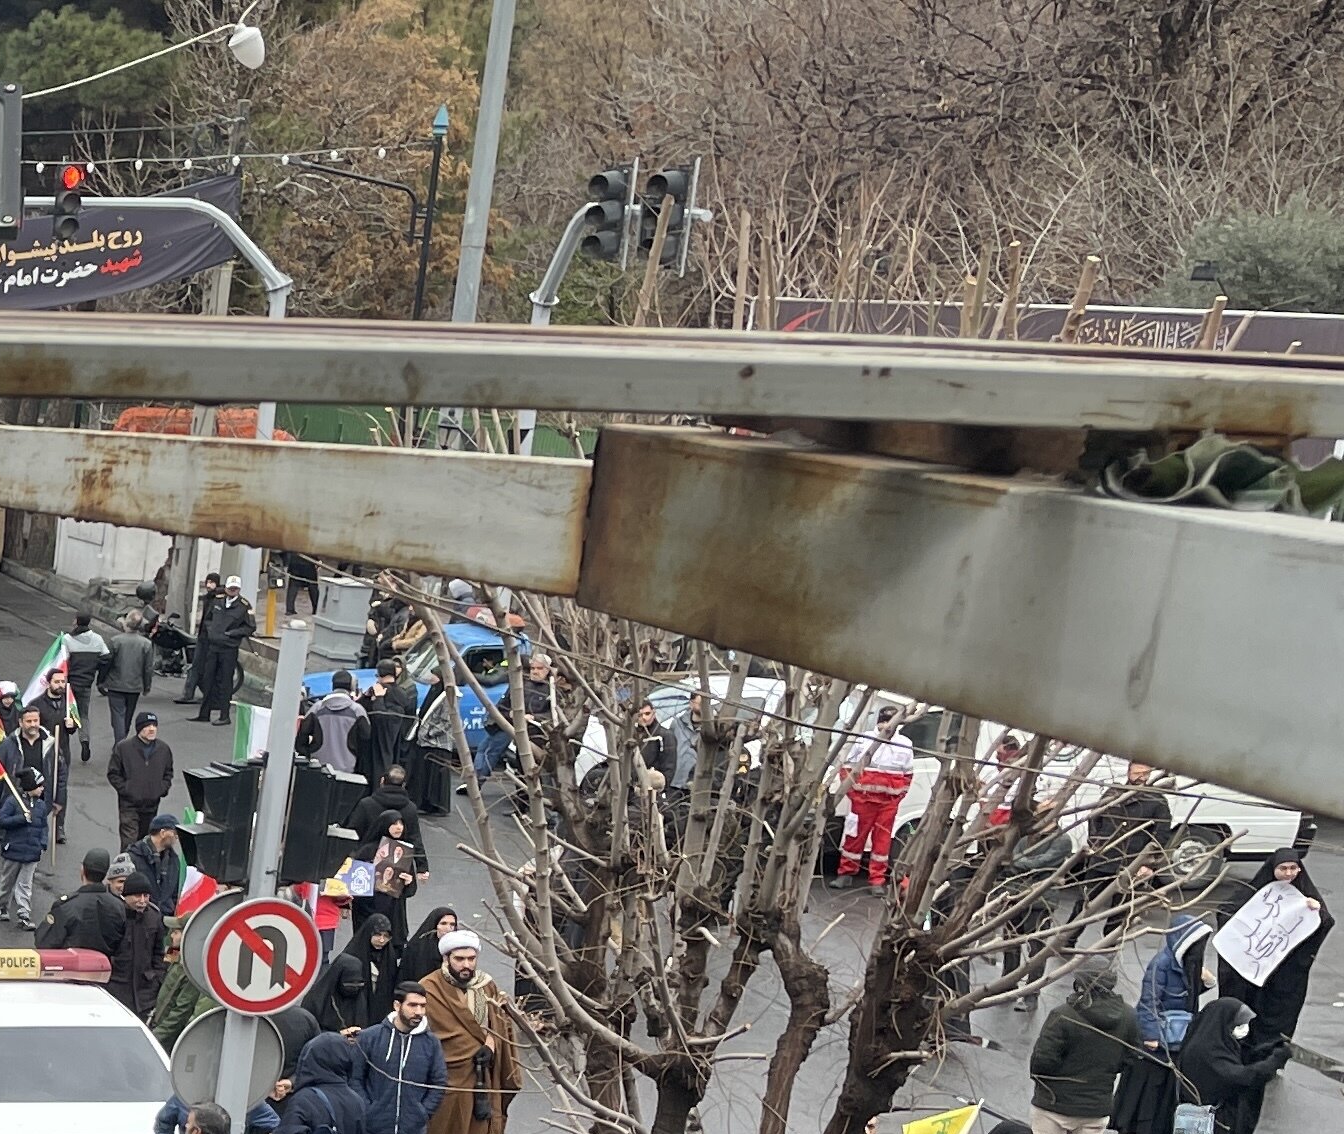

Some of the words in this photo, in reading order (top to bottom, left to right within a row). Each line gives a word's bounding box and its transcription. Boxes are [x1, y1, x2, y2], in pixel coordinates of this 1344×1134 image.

[108, 230, 143, 250] روح
[41, 261, 98, 288] حضرت
[99, 250, 143, 275] شهید
[3, 267, 39, 293] امام
[0, 957, 36, 968] POLICE
